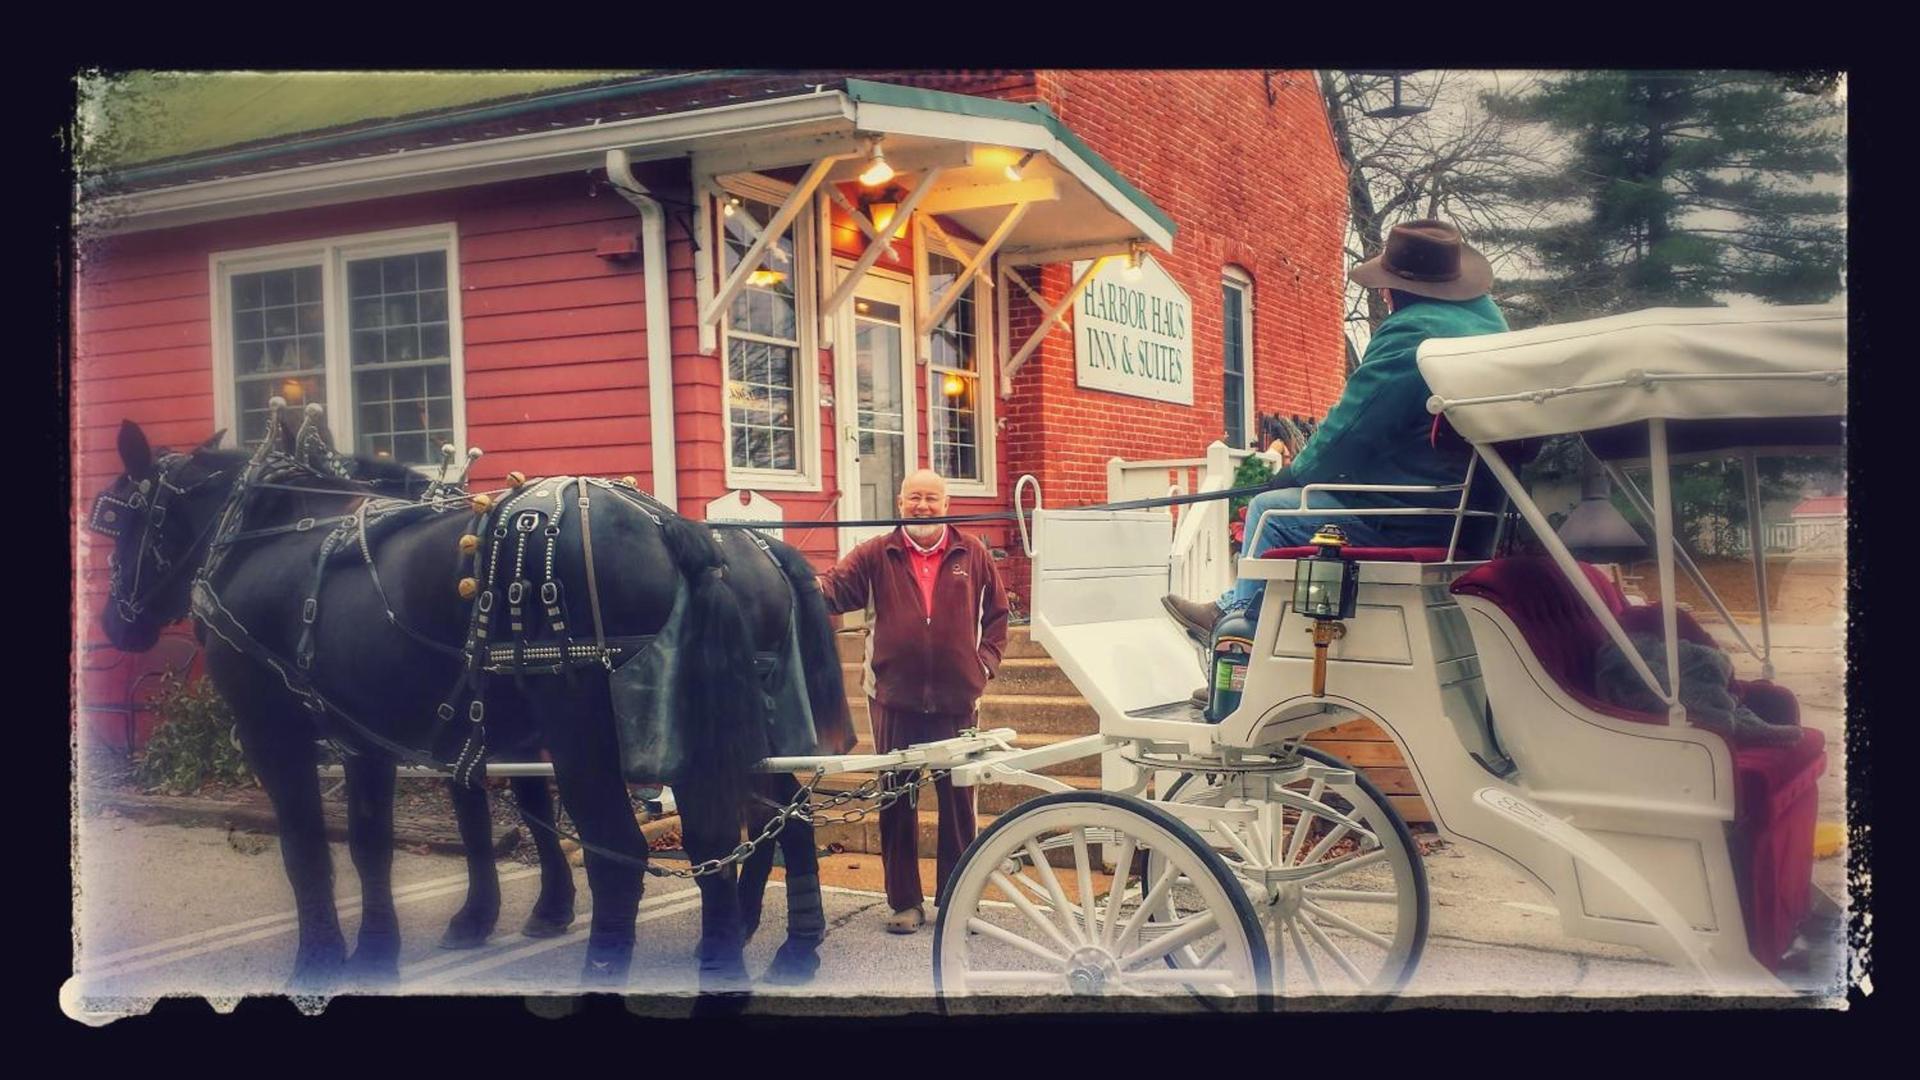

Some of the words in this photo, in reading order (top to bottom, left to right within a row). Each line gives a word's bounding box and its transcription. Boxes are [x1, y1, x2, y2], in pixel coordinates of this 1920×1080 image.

[1084, 278, 1147, 331] HARBOR
[1151, 296, 1185, 340] HAUS
[1086, 327, 1117, 370] INN
[1121, 335, 1134, 374] &
[1138, 339, 1183, 385] SUITES
